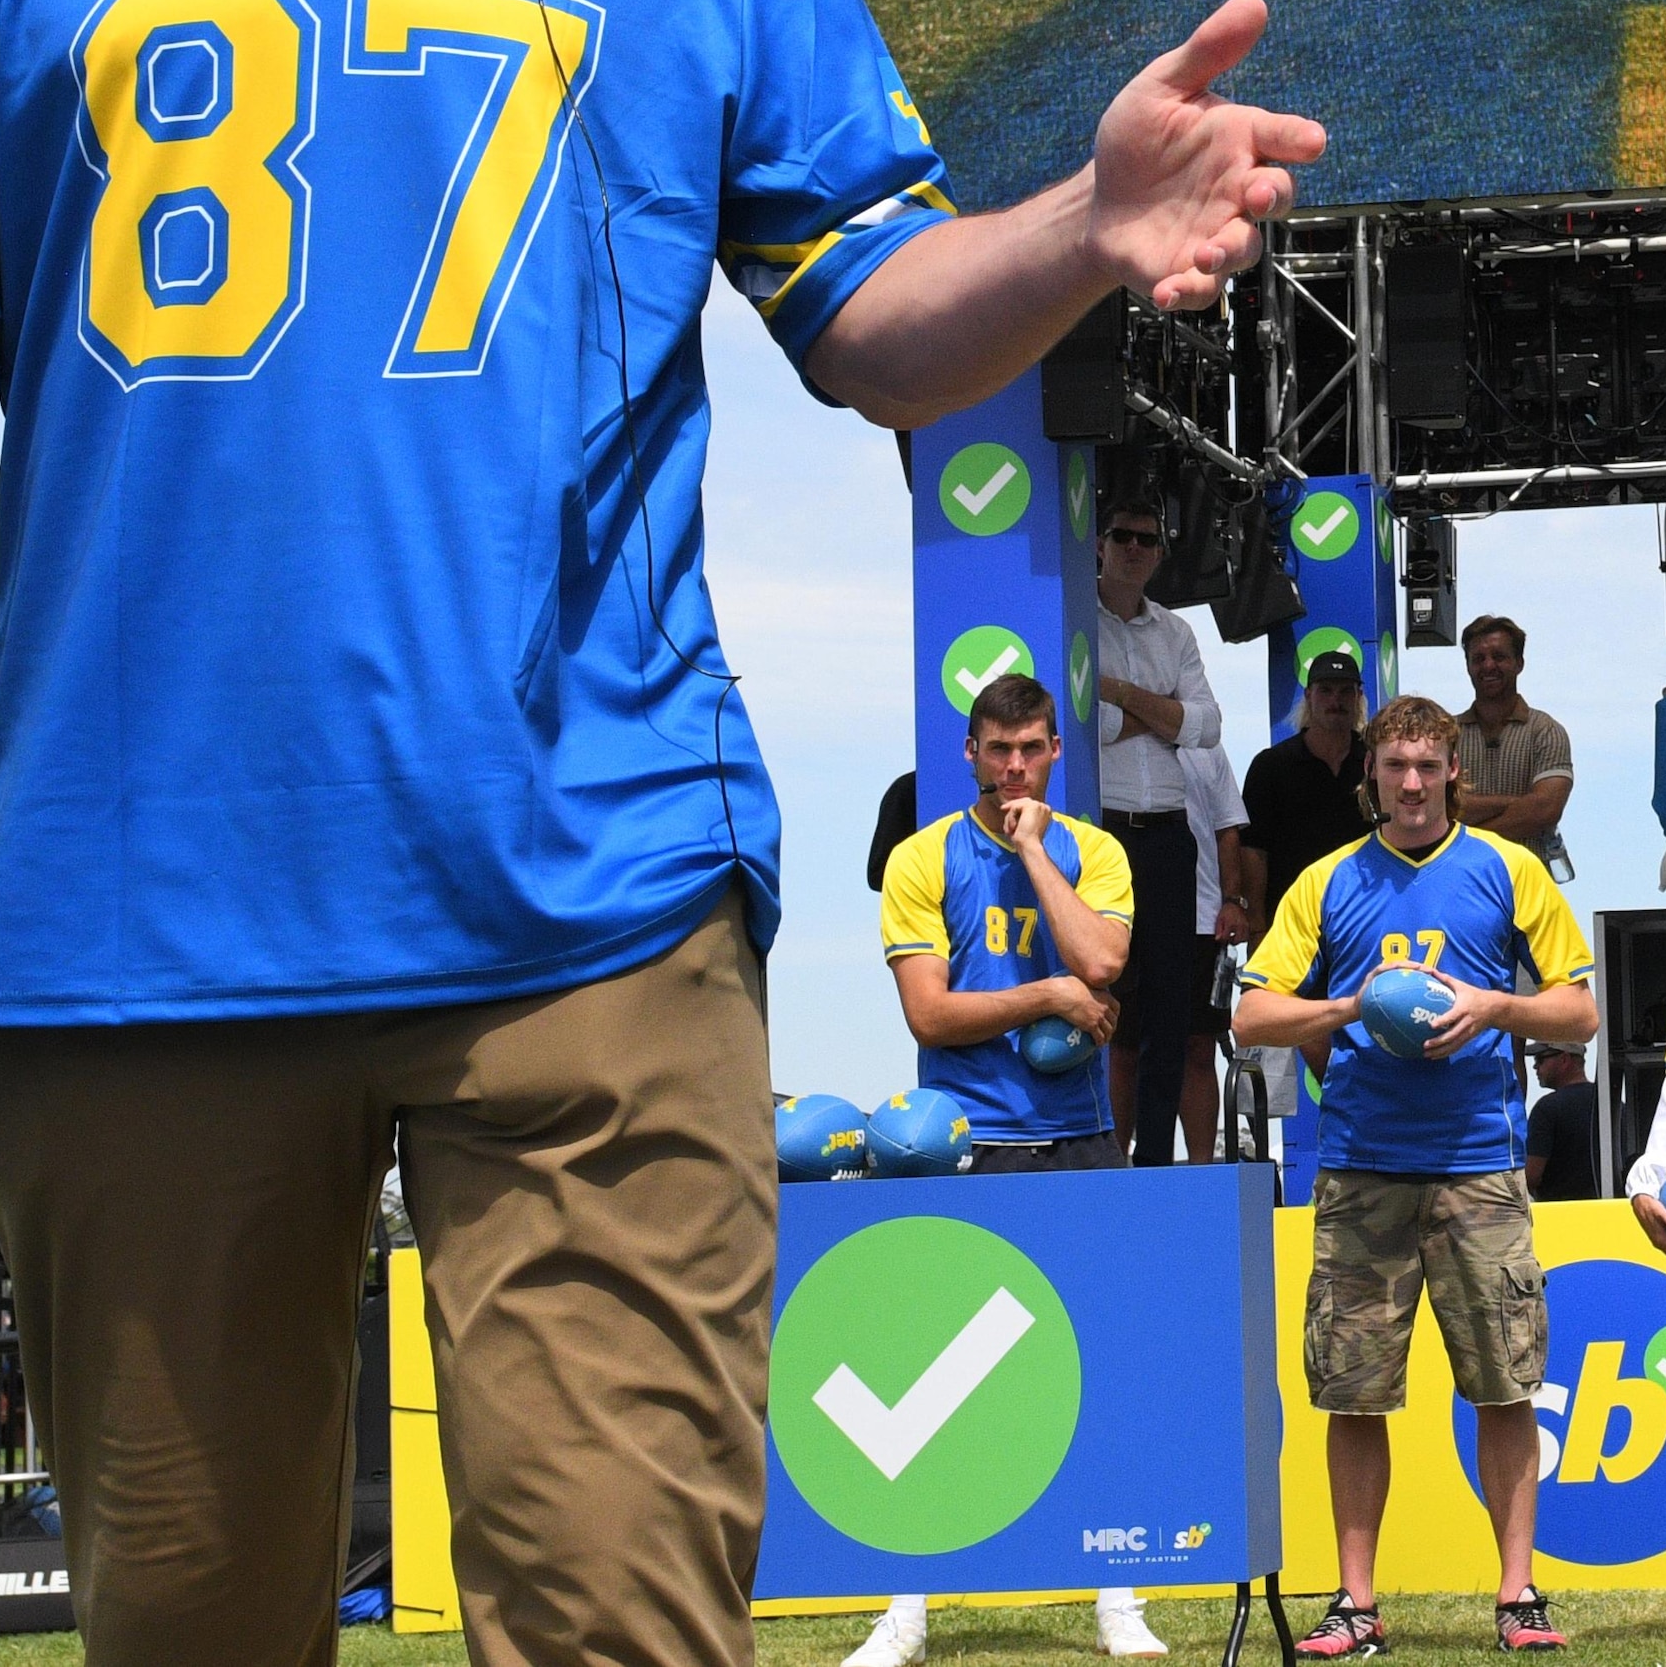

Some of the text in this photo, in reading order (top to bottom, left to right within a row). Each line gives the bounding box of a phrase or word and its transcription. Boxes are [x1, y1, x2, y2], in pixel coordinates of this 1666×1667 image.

[985, 905, 1039, 958] 87
[1083, 1525, 1205, 1552] MRC sb
[1145, 1555, 1189, 1563] PARTNER
